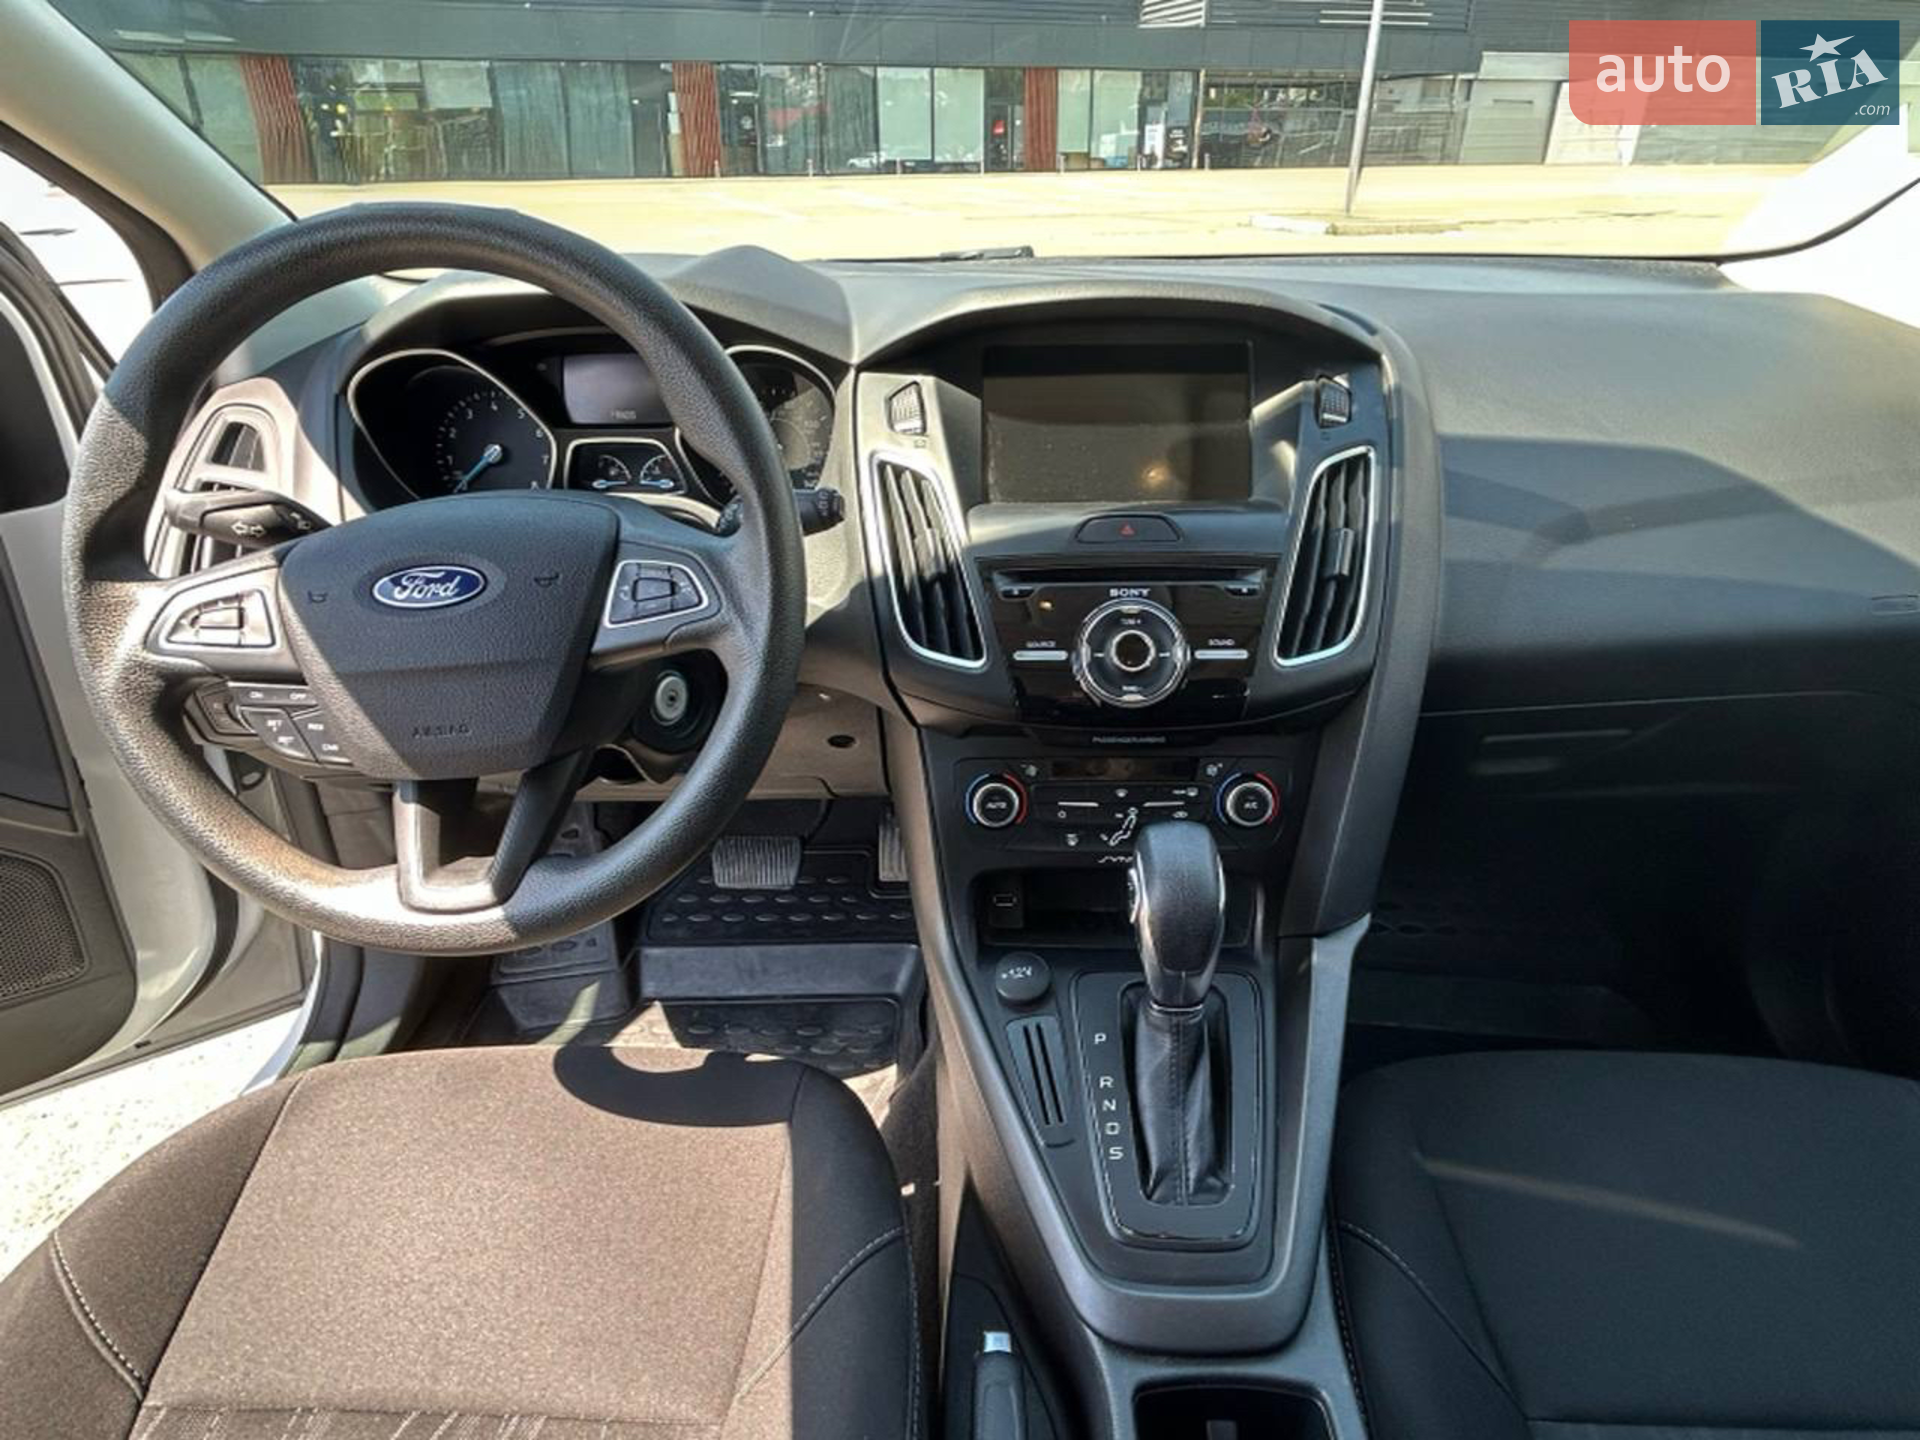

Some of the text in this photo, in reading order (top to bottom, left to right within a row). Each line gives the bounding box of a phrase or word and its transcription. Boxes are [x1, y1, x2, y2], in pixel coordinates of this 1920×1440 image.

[517, 408, 525, 419] 5
[448, 427, 457, 438] 2
[394, 570, 462, 600] Ford
[1109, 587, 1151, 598] SONY
[1094, 1033, 1107, 1045] P
[1099, 1076, 1115, 1089] R
[1102, 1099, 1117, 1112] N
[1108, 1147, 1124, 1160] S
